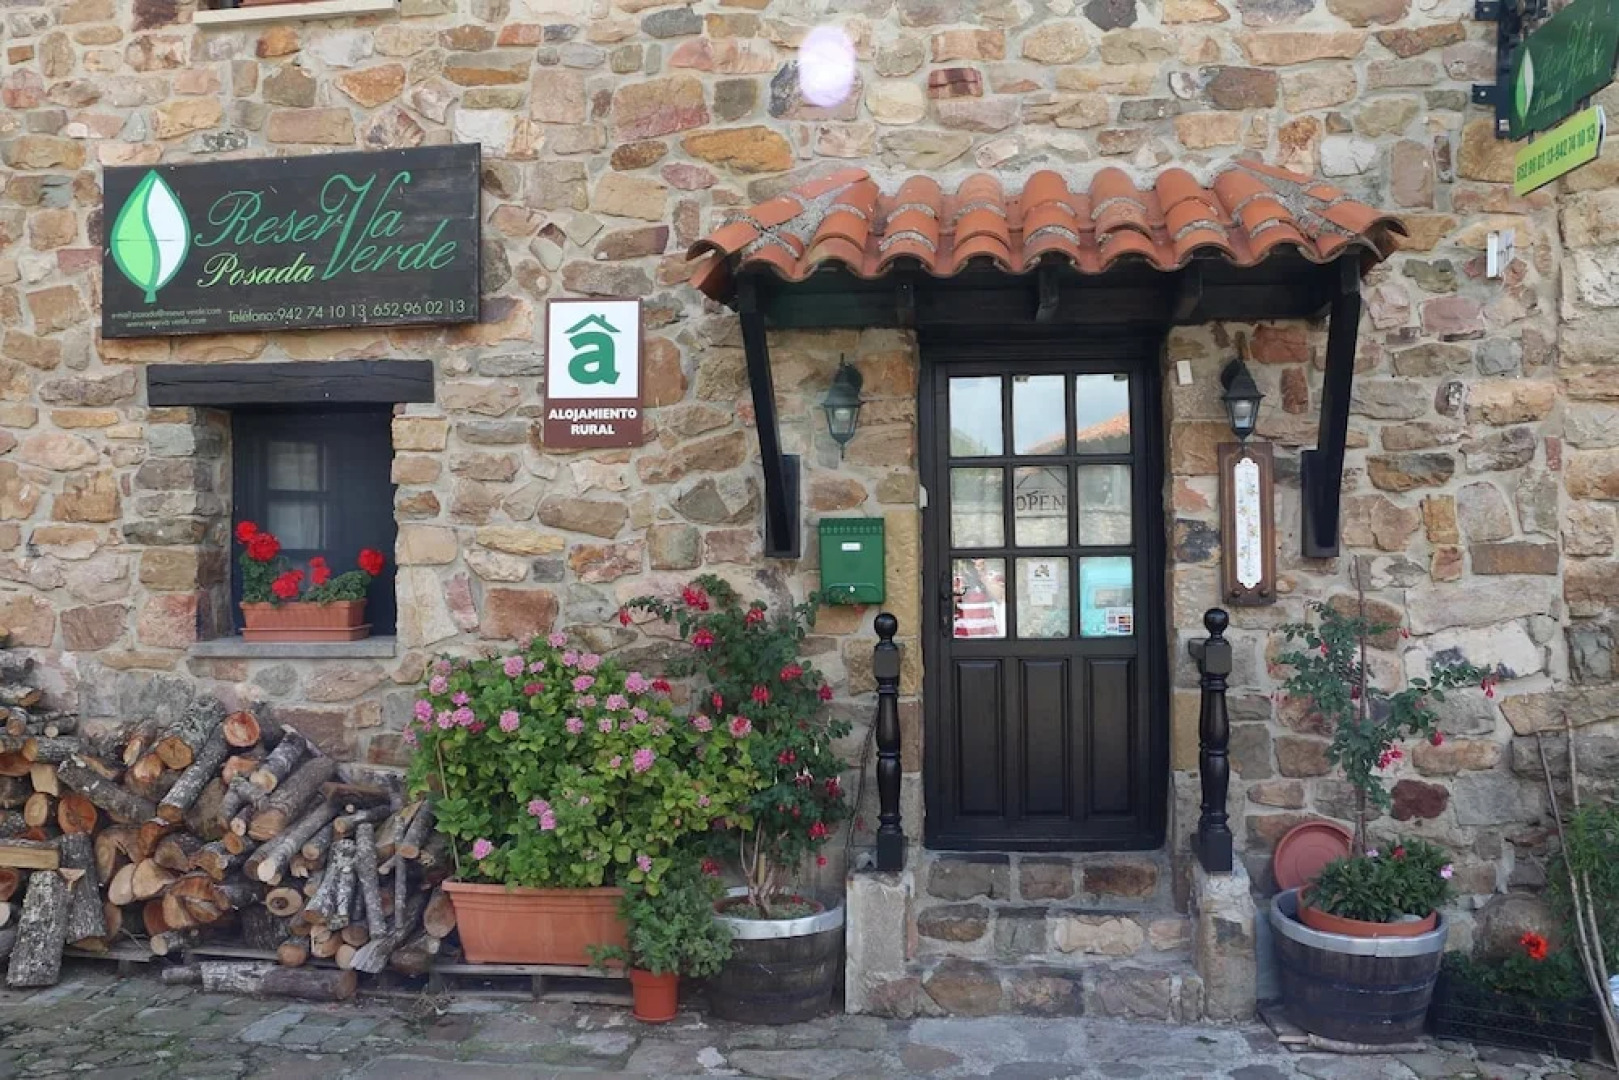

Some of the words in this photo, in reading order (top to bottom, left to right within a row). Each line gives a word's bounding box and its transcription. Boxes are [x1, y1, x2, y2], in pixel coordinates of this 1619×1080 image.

[198, 252, 316, 288] Posada
[307, 305, 324, 320] 74
[330, 305, 346, 319] 10
[351, 303, 367, 318] 13
[403, 301, 421, 315] 96
[425, 300, 443, 315] 02
[449, 299, 466, 314] 13
[549, 407, 637, 422] ALOJAMIENTO
[570, 423, 615, 436] RURAL
[1016, 494, 1067, 512] OPEN
